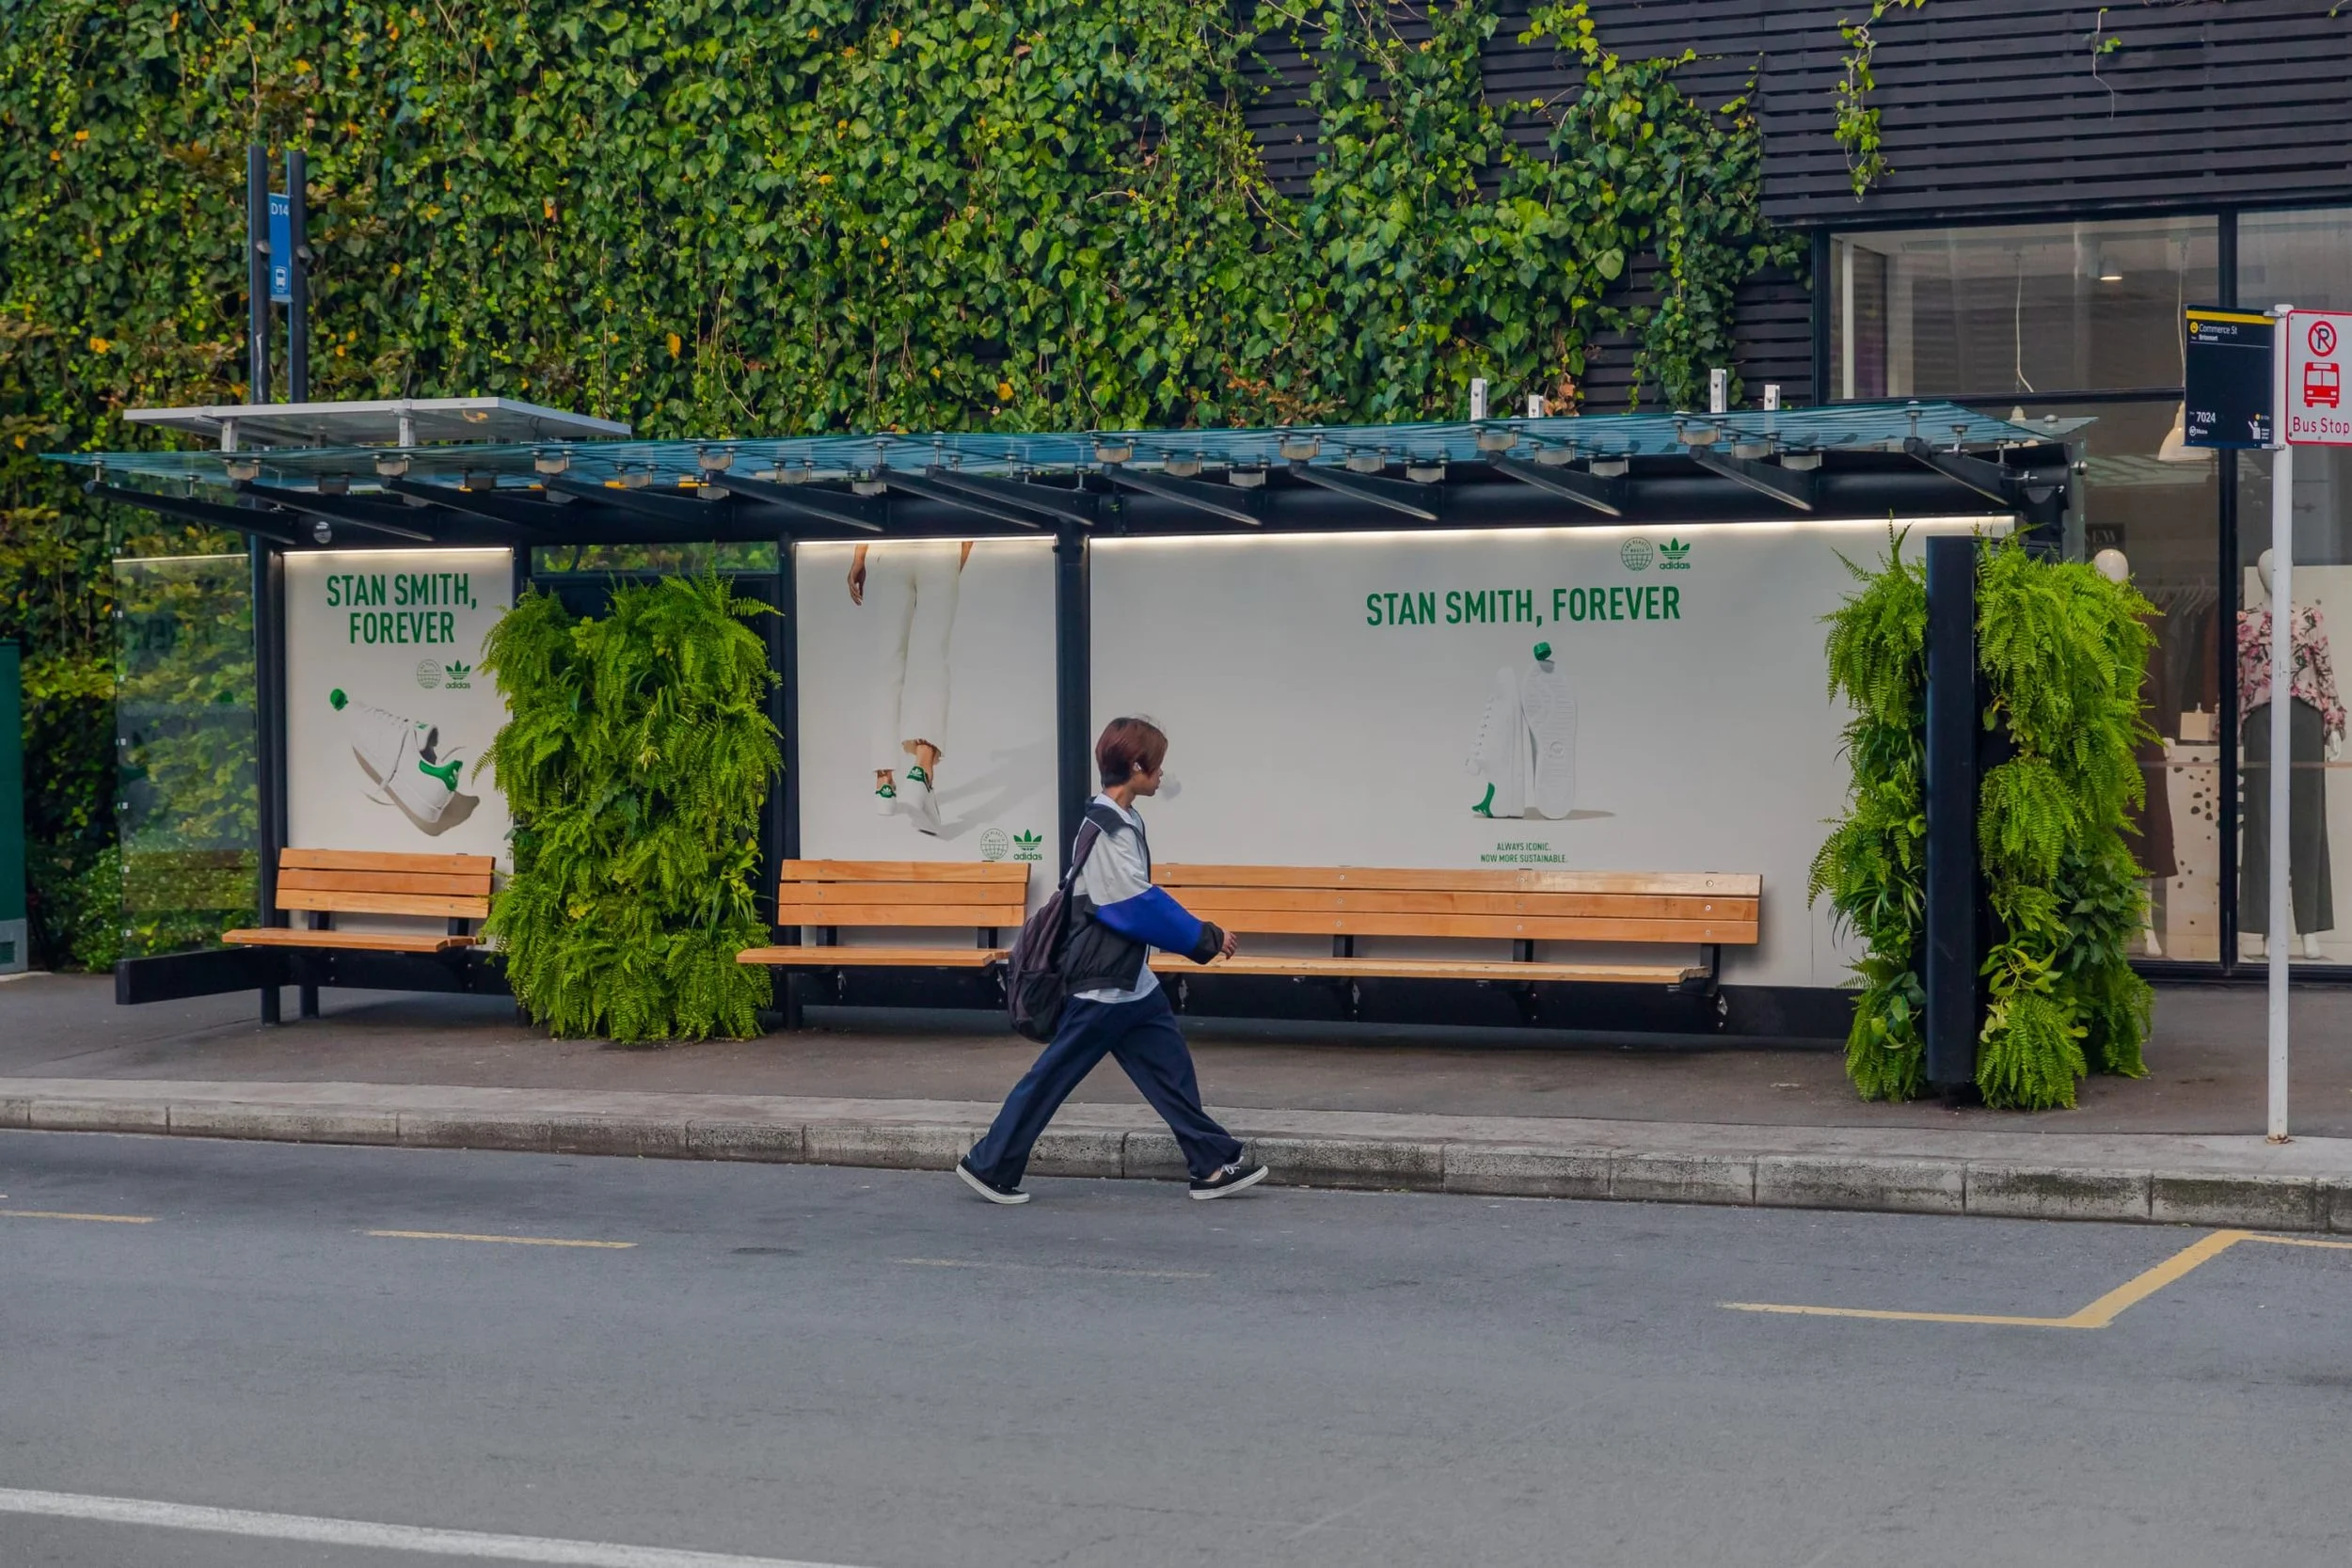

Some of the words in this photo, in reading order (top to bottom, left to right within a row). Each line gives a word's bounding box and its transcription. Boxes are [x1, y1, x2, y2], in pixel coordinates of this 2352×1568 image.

[271, 202, 289, 215] D14
[2199, 324, 2230, 334] Commerce
[2231, 326, 2238, 335] St
[2196, 411, 2217, 422] 7024
[2293, 417, 2317, 433] Bus
[2320, 417, 2350, 436] Stop
[1659, 561, 1691, 570] adidas
[326, 575, 387, 607] STAN
[393, 573, 477, 610] SMITH,
[1366, 592, 1437, 626] STAN
[1445, 589, 1543, 628] SMITH,
[1552, 586, 1681, 622] FOREVER
[349, 611, 454, 644] FOREVER
[445, 681, 470, 689] adidas
[1497, 843, 1524, 851] ALWAYS
[1525, 843, 1551, 851] ICONIC.
[1013, 852, 1043, 861] adidas
[1481, 854, 1498, 863] NOW
[1499, 854, 1518, 863] MORE
